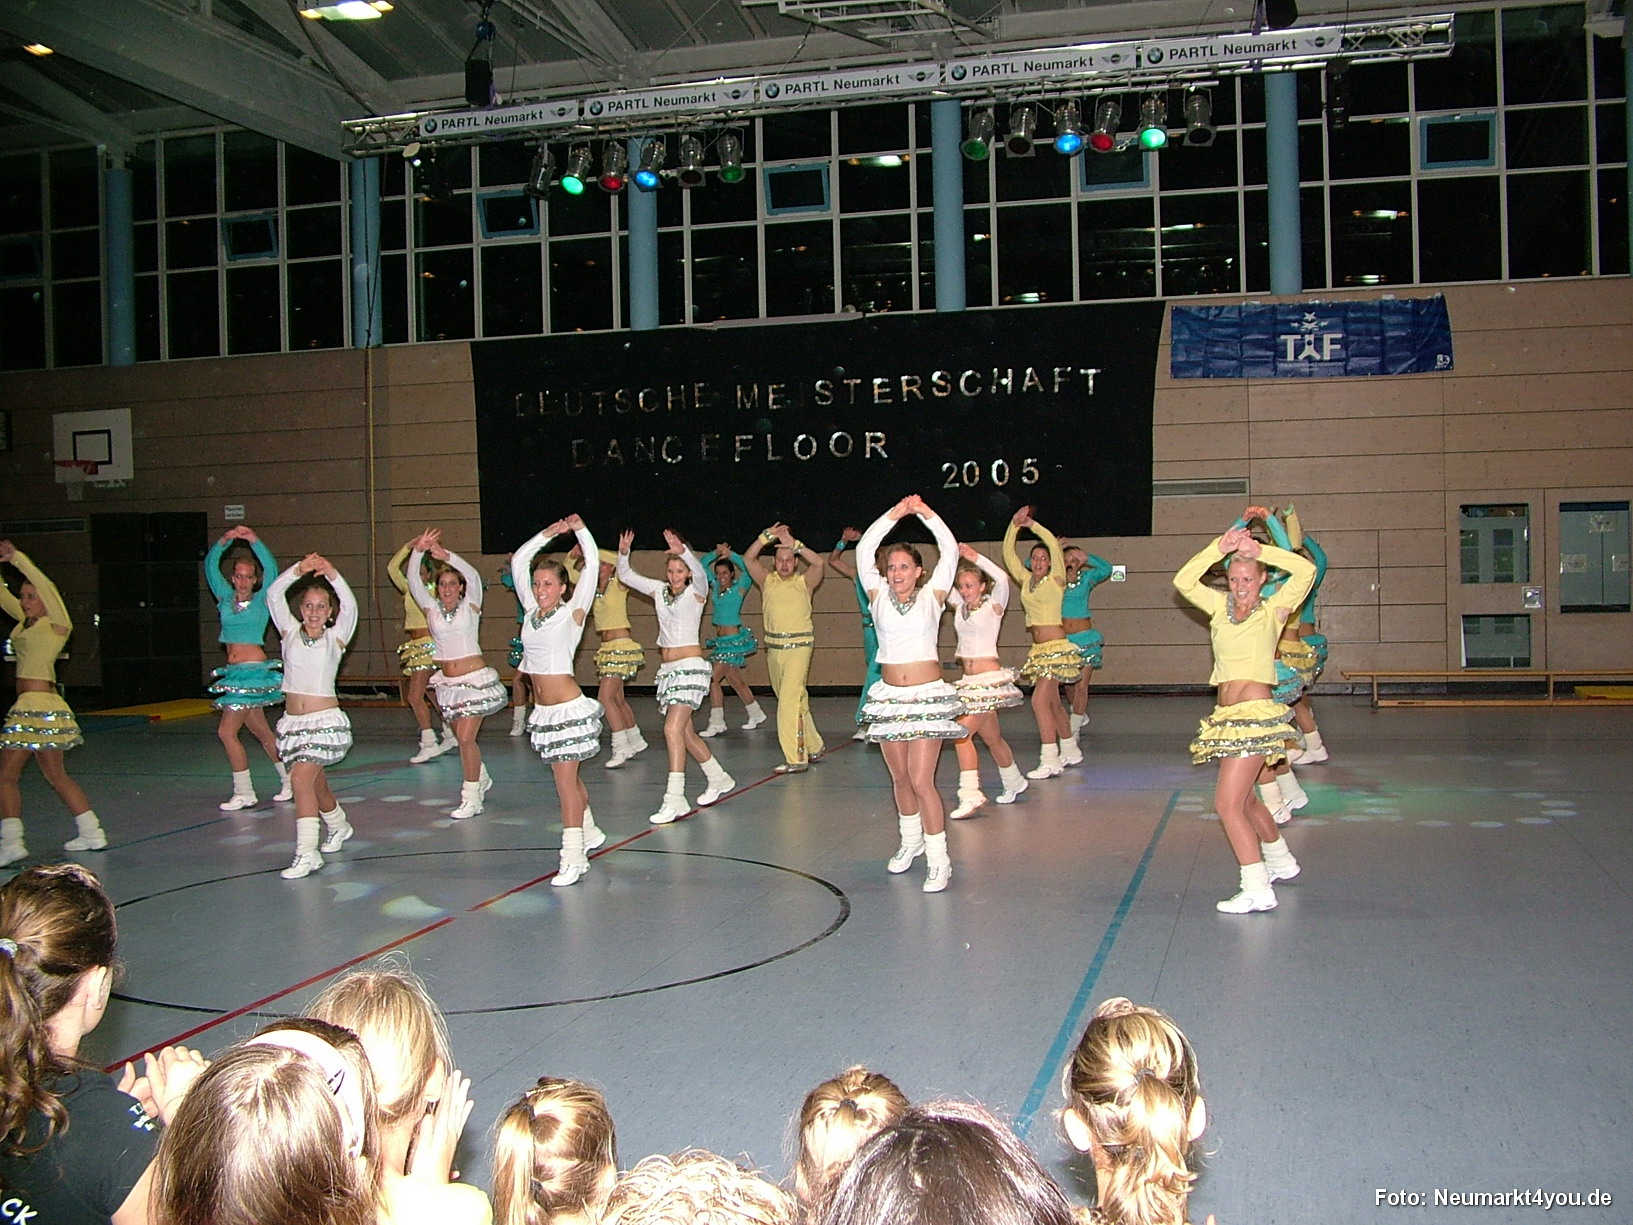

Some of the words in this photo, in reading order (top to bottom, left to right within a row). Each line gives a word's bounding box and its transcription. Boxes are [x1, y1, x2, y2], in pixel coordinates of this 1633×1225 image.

[1169, 45, 1218, 60] PARTL
[1223, 38, 1297, 56] Neumarkt
[972, 62, 1019, 77] PARTL
[1023, 56, 1094, 72] Neumarkt
[785, 81, 829, 95] PARTL
[833, 73, 900, 90] Neumarkt
[608, 98, 649, 112] PARTL
[653, 92, 717, 107] Neumarkt
[441, 116, 480, 130] PARTL
[484, 110, 544, 125] Neumarkt
[941, 458, 1040, 489] 2005
